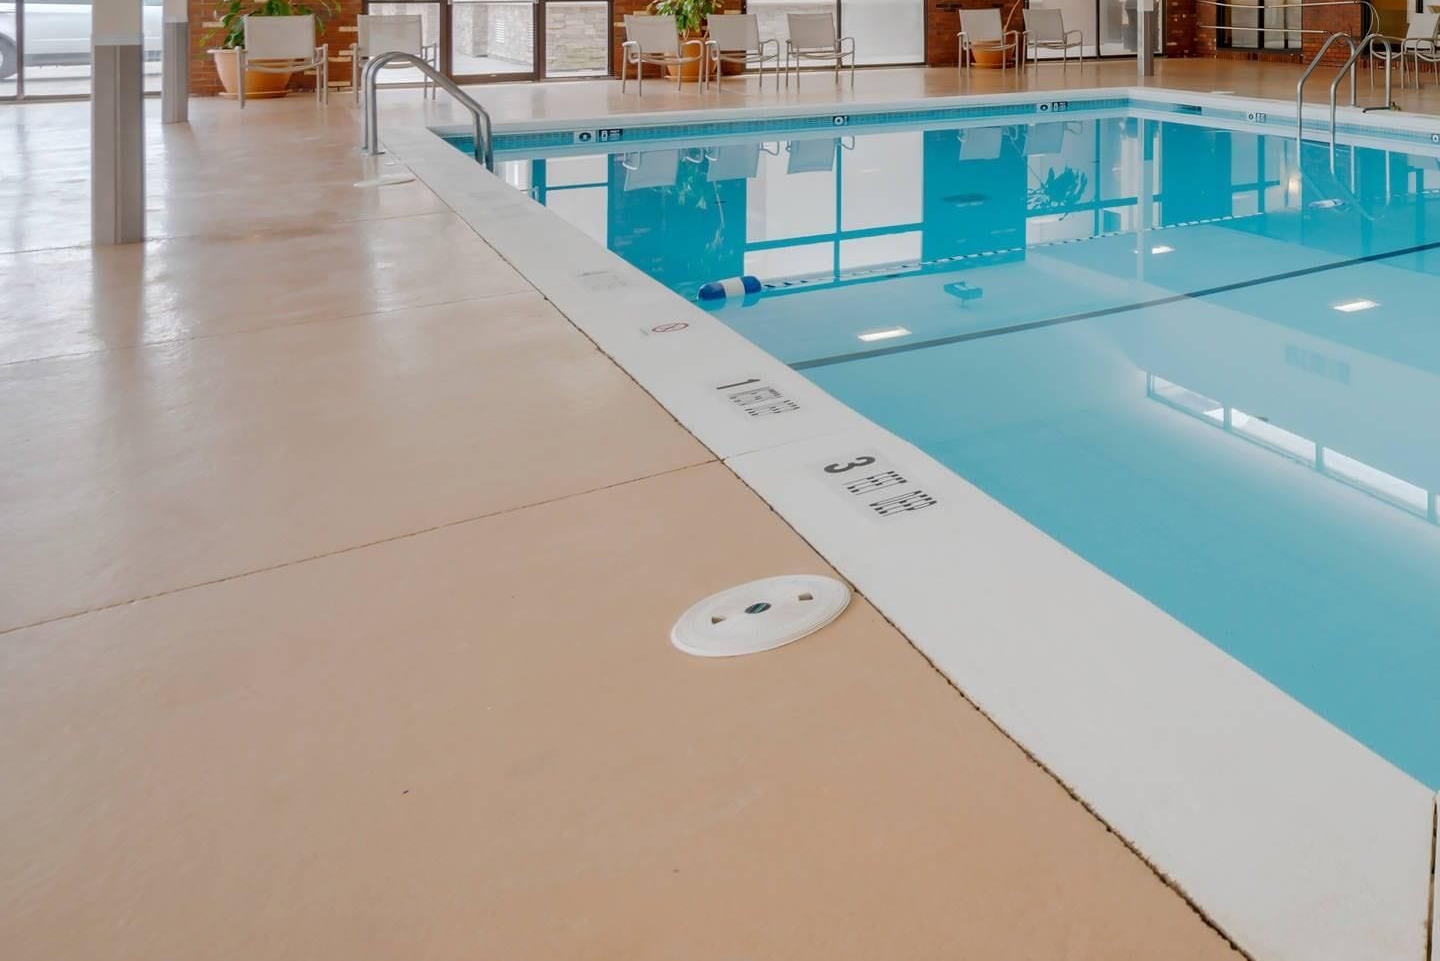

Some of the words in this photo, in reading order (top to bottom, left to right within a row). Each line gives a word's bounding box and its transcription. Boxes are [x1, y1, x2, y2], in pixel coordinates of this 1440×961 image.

[824, 456, 876, 473] 3
[842, 471, 907, 495] FEET
[869, 490, 937, 517] DEEP
